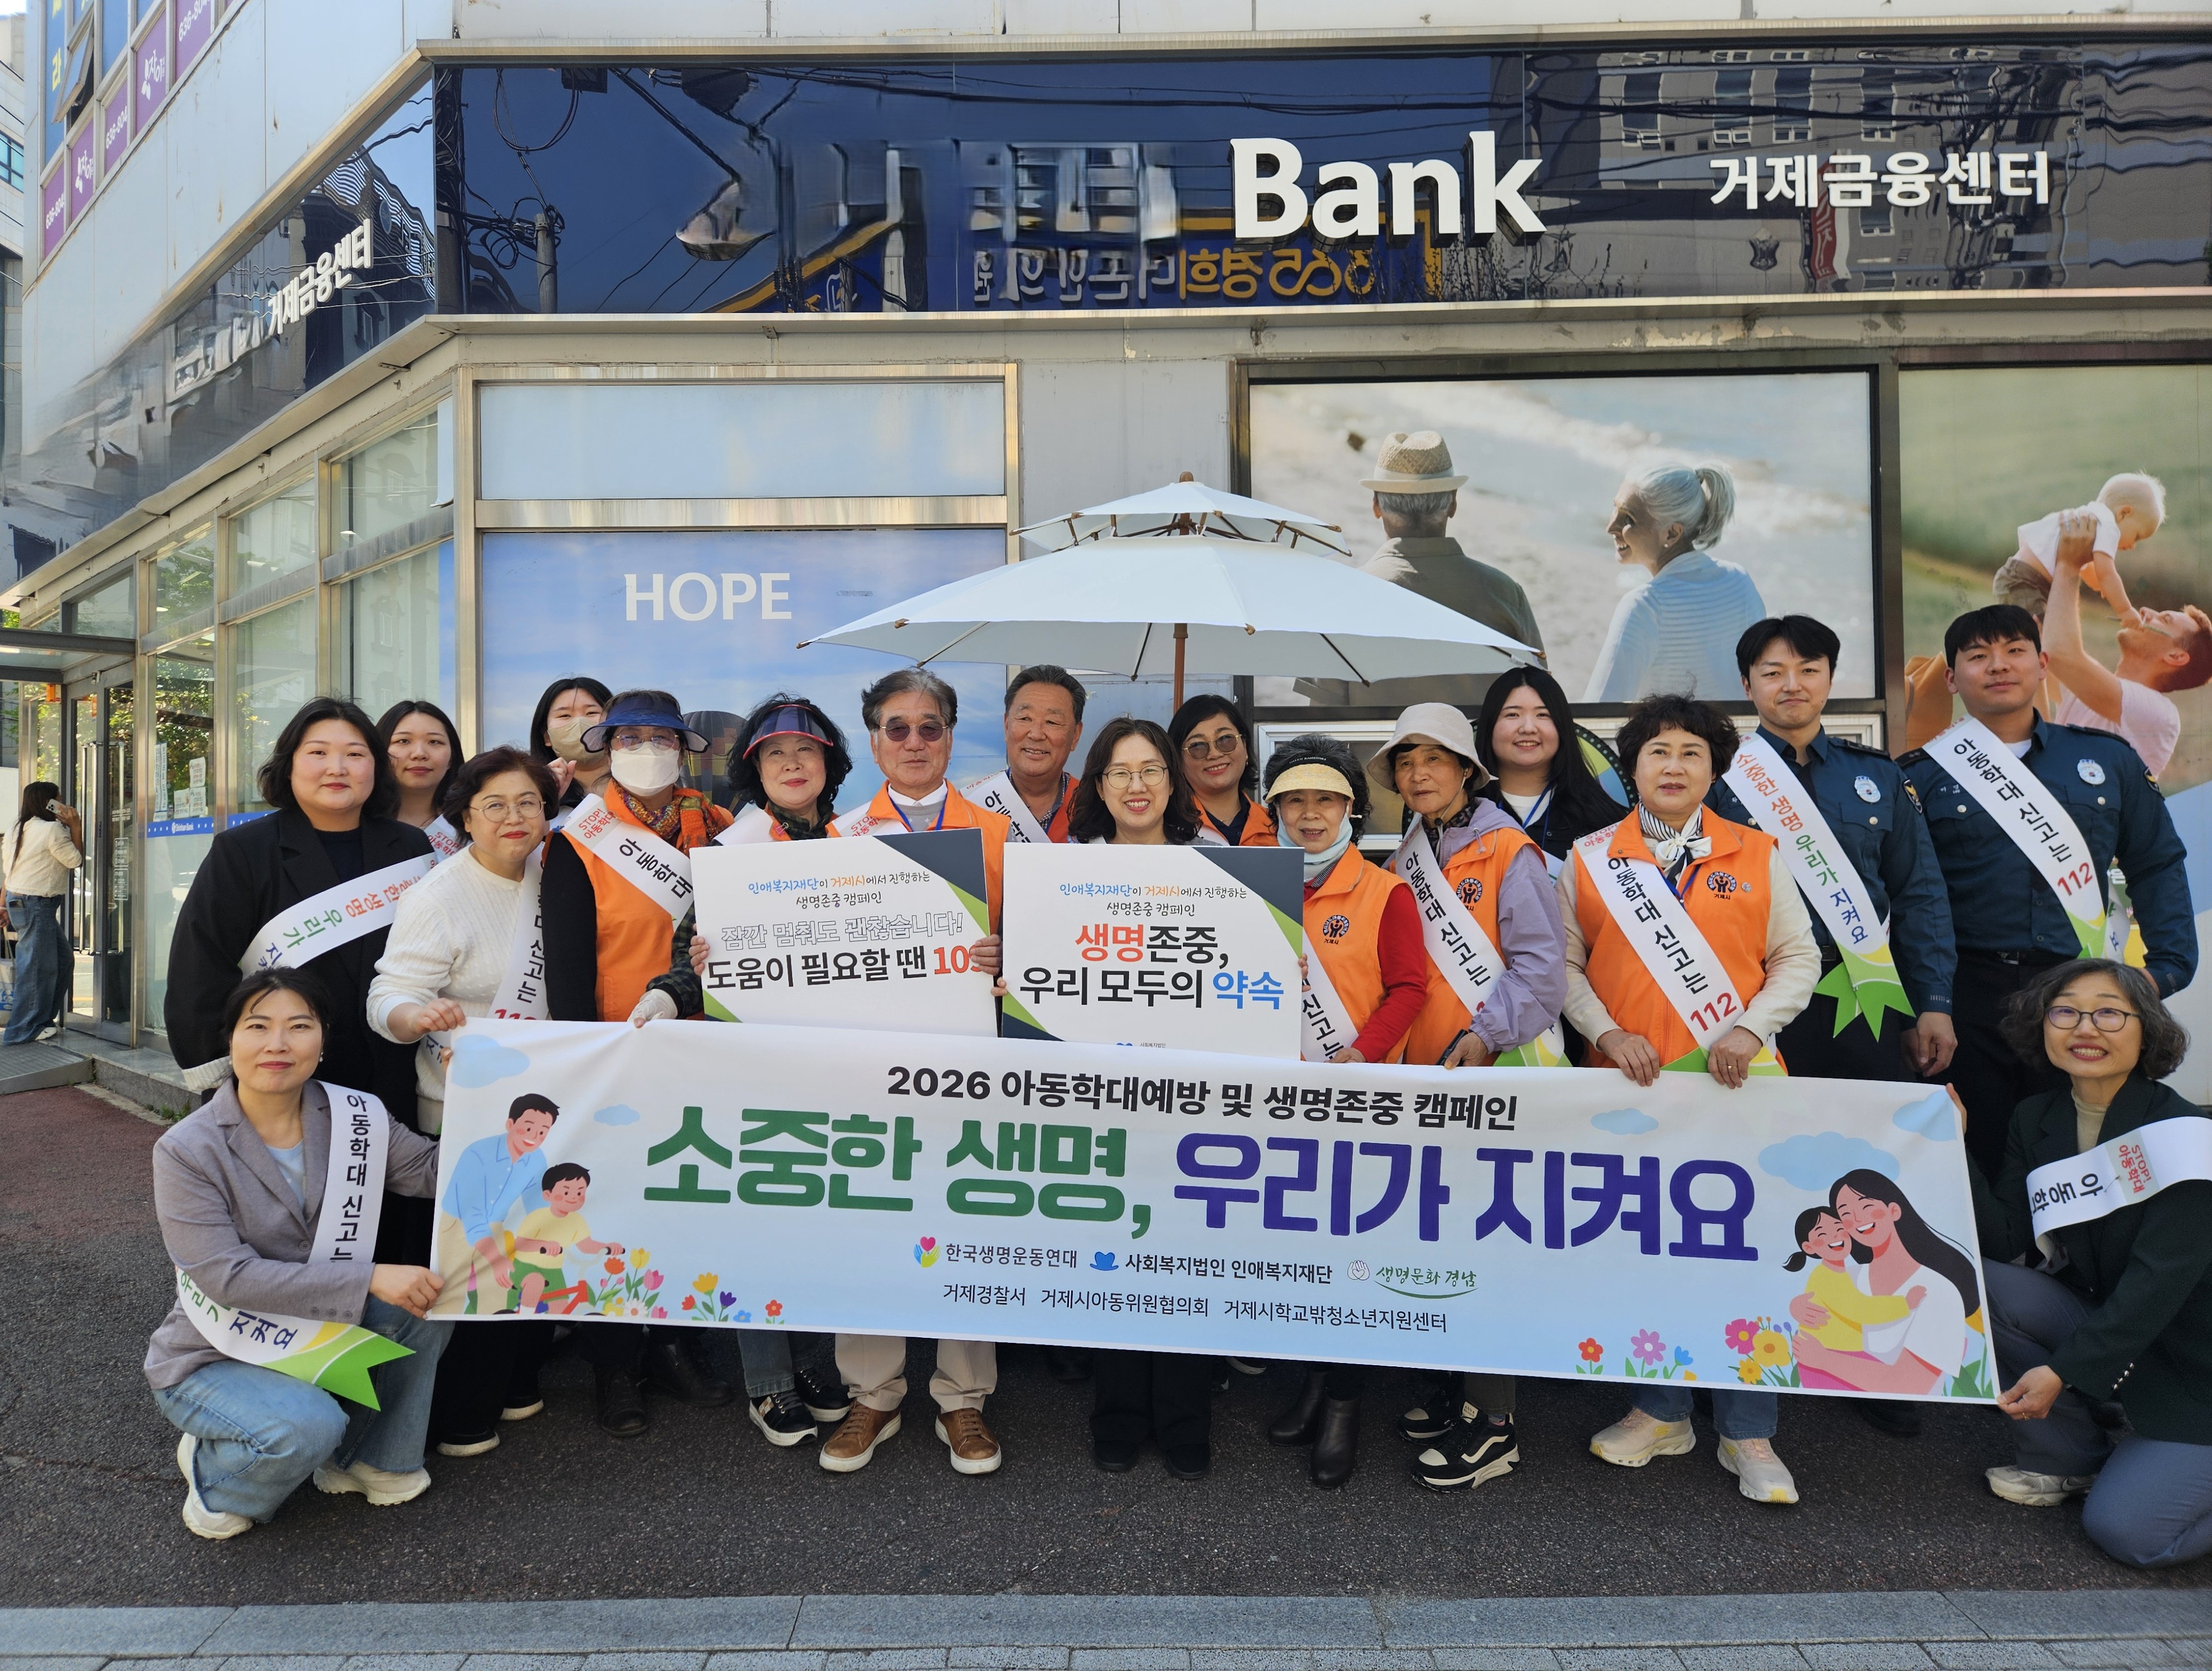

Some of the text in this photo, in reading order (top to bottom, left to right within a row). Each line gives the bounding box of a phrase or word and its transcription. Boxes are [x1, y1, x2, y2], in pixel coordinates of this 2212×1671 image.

[1230, 130, 1547, 241] Bank
[1710, 150, 2049, 209] 거제금융센터
[268, 218, 374, 334] 거제금융센터
[624, 572, 792, 622] HOPE
[579, 808, 605, 830] STOP!
[851, 816, 872, 832] STO
[1954, 739, 2093, 896] 아동학대 신고는 112
[619, 838, 694, 899] 아동학대
[1736, 754, 1868, 944] 소중한 생명 우리가 지켜요
[345, 892, 384, 917] 생명
[748, 871, 930, 895] 인애복지재단이 거제시에서 진행하는
[796, 891, 882, 910] 생명존중 캠페인
[1060, 882, 1247, 898] 인애복지재단이 거제시에서 진행하는
[283, 909, 343, 949] 우리가
[721, 911, 964, 951] 잠깐 멈춰도 괜찮습니다!
[1107, 901, 1195, 917] 생명존중 캠페인
[1405, 851, 1447, 924] 아동학대
[1441, 921, 1491, 987] 신고는
[707, 954, 794, 990] 도움이
[801, 948, 891, 986] 필요할
[897, 945, 928, 979] 땐
[1075, 924, 1228, 969] 생명존중,
[1608, 858, 1737, 1032] 아동학대 신고는 112
[1020, 966, 1283, 1010] 우리 모두의 약속
[888, 1066, 1517, 1131] 2026 아동학대예방 및 생명존중 캠페인
[345, 1094, 371, 1188] 아동학대
[644, 1106, 1759, 1262] 소중한 생명, 우리가 지켜요
[2118, 1145, 2145, 1194] 아동학대
[2132, 1145, 2152, 1183] STOP!
[946, 1243, 1077, 1268] 한국생명운동연대
[1125, 1253, 1333, 1284] 사회복지법인 인애복지재단
[1375, 1264, 1477, 1288] 생명문화 경남
[229, 1310, 298, 1349] 지켜요
[943, 1283, 1447, 1333] 거제경찰서 거제시아동위원협의회 거제시학교밖청소년지원센터
